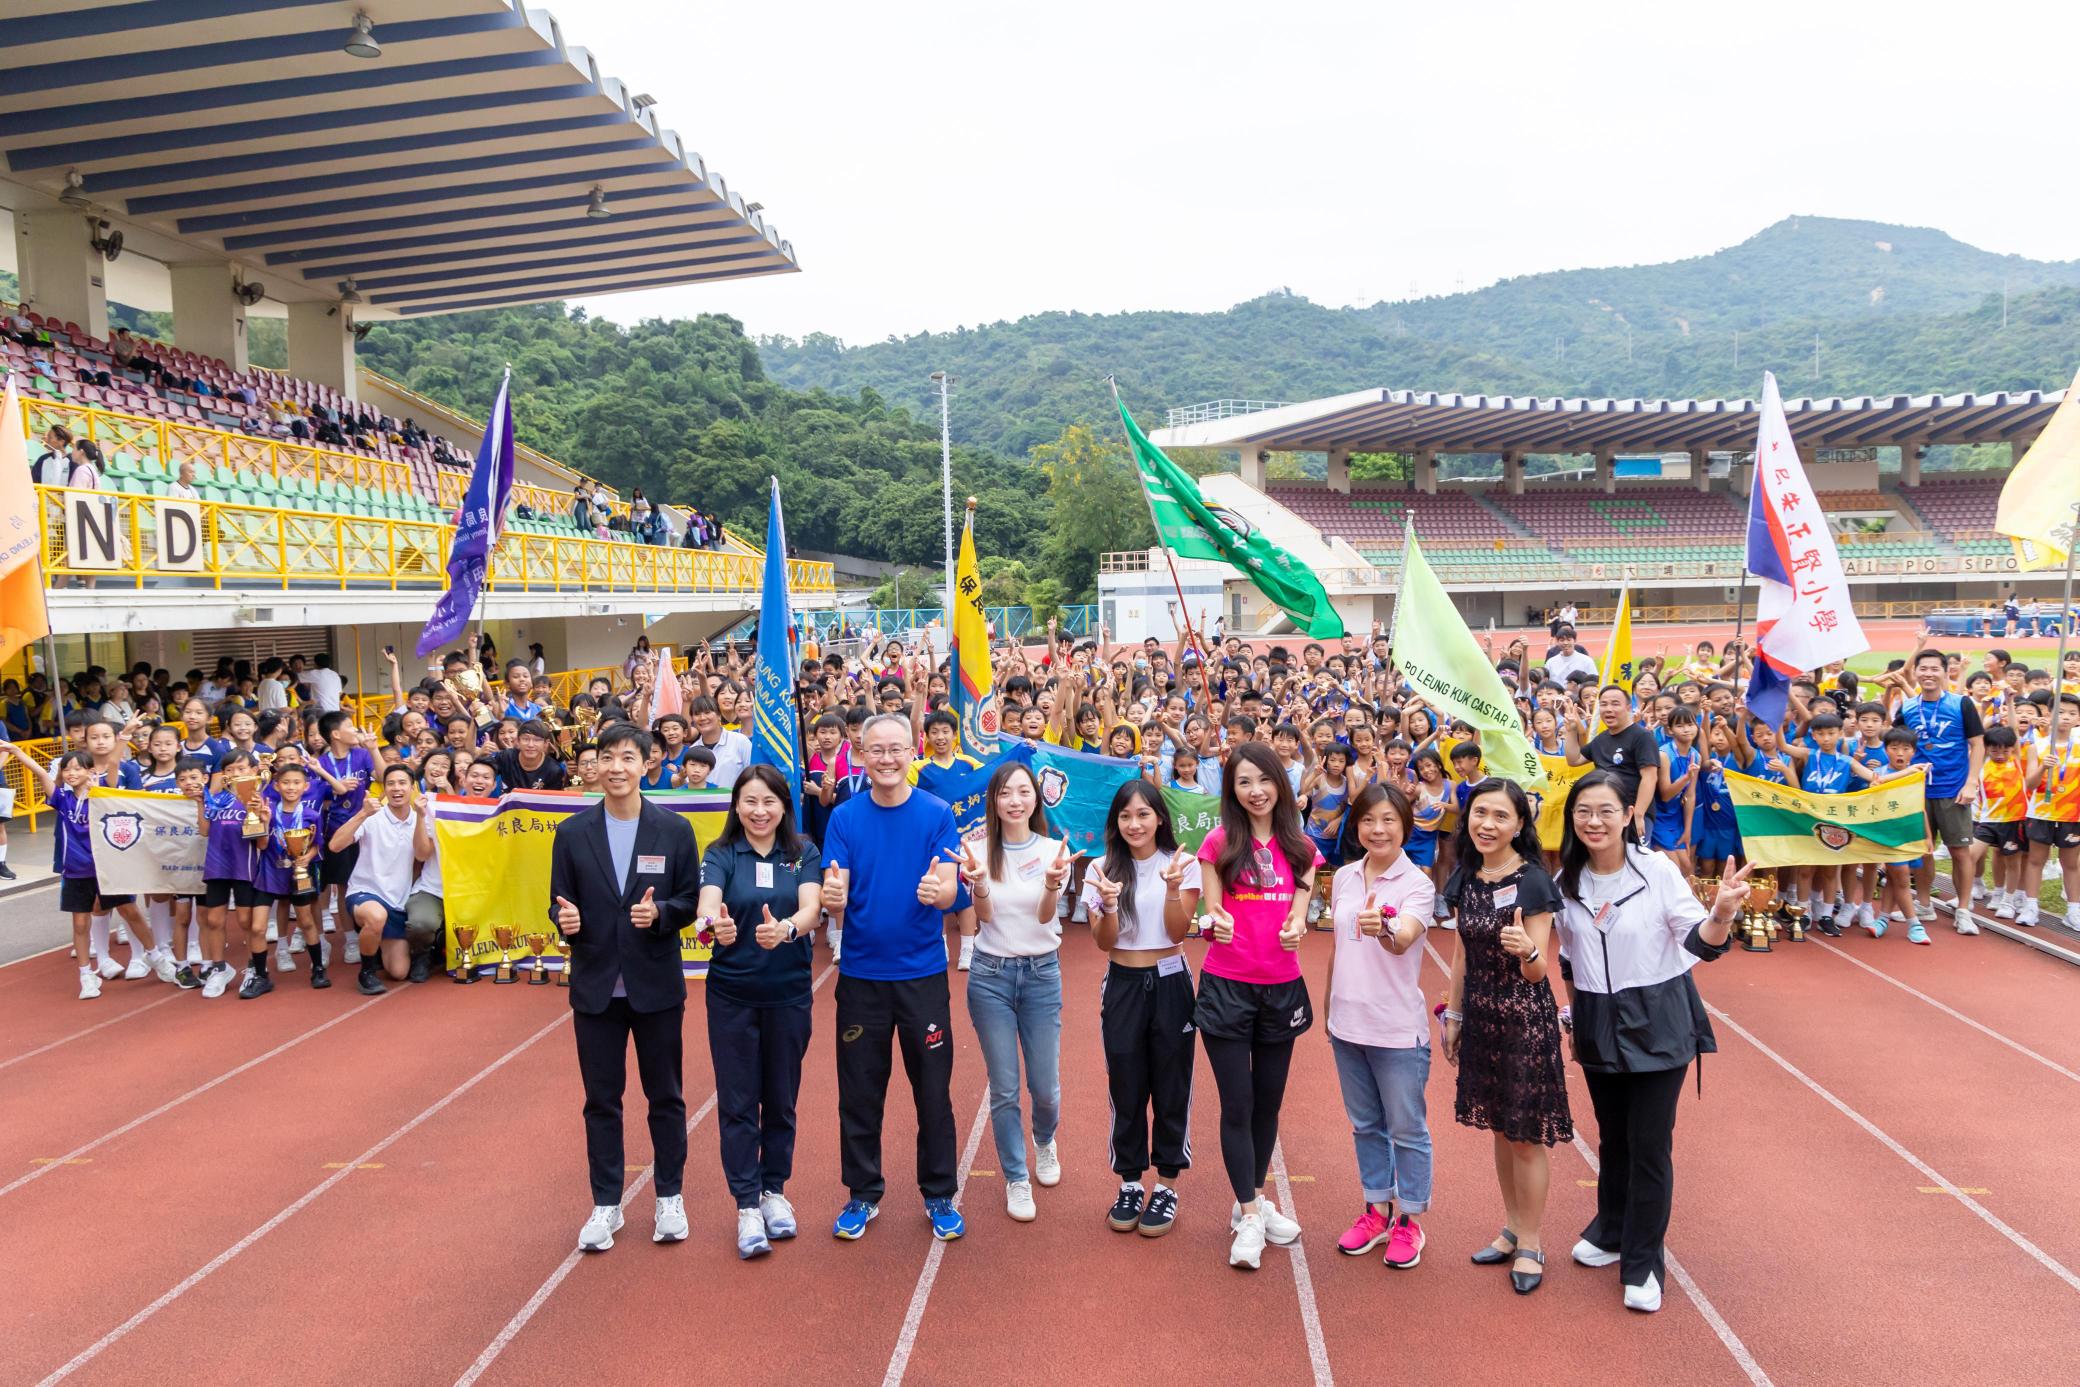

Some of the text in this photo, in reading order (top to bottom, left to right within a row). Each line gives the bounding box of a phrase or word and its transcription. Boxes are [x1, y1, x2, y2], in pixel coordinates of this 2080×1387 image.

[236, 318, 243, 336] 7
[1906, 559, 1935, 571] PO
[1404, 660, 1417, 676] PO
[1416, 669, 1451, 696] LEUNG
[1449, 686, 1472, 707] KUK
[1470, 697, 1509, 727] CASTAR
[471, 940, 500, 957] LEUN
